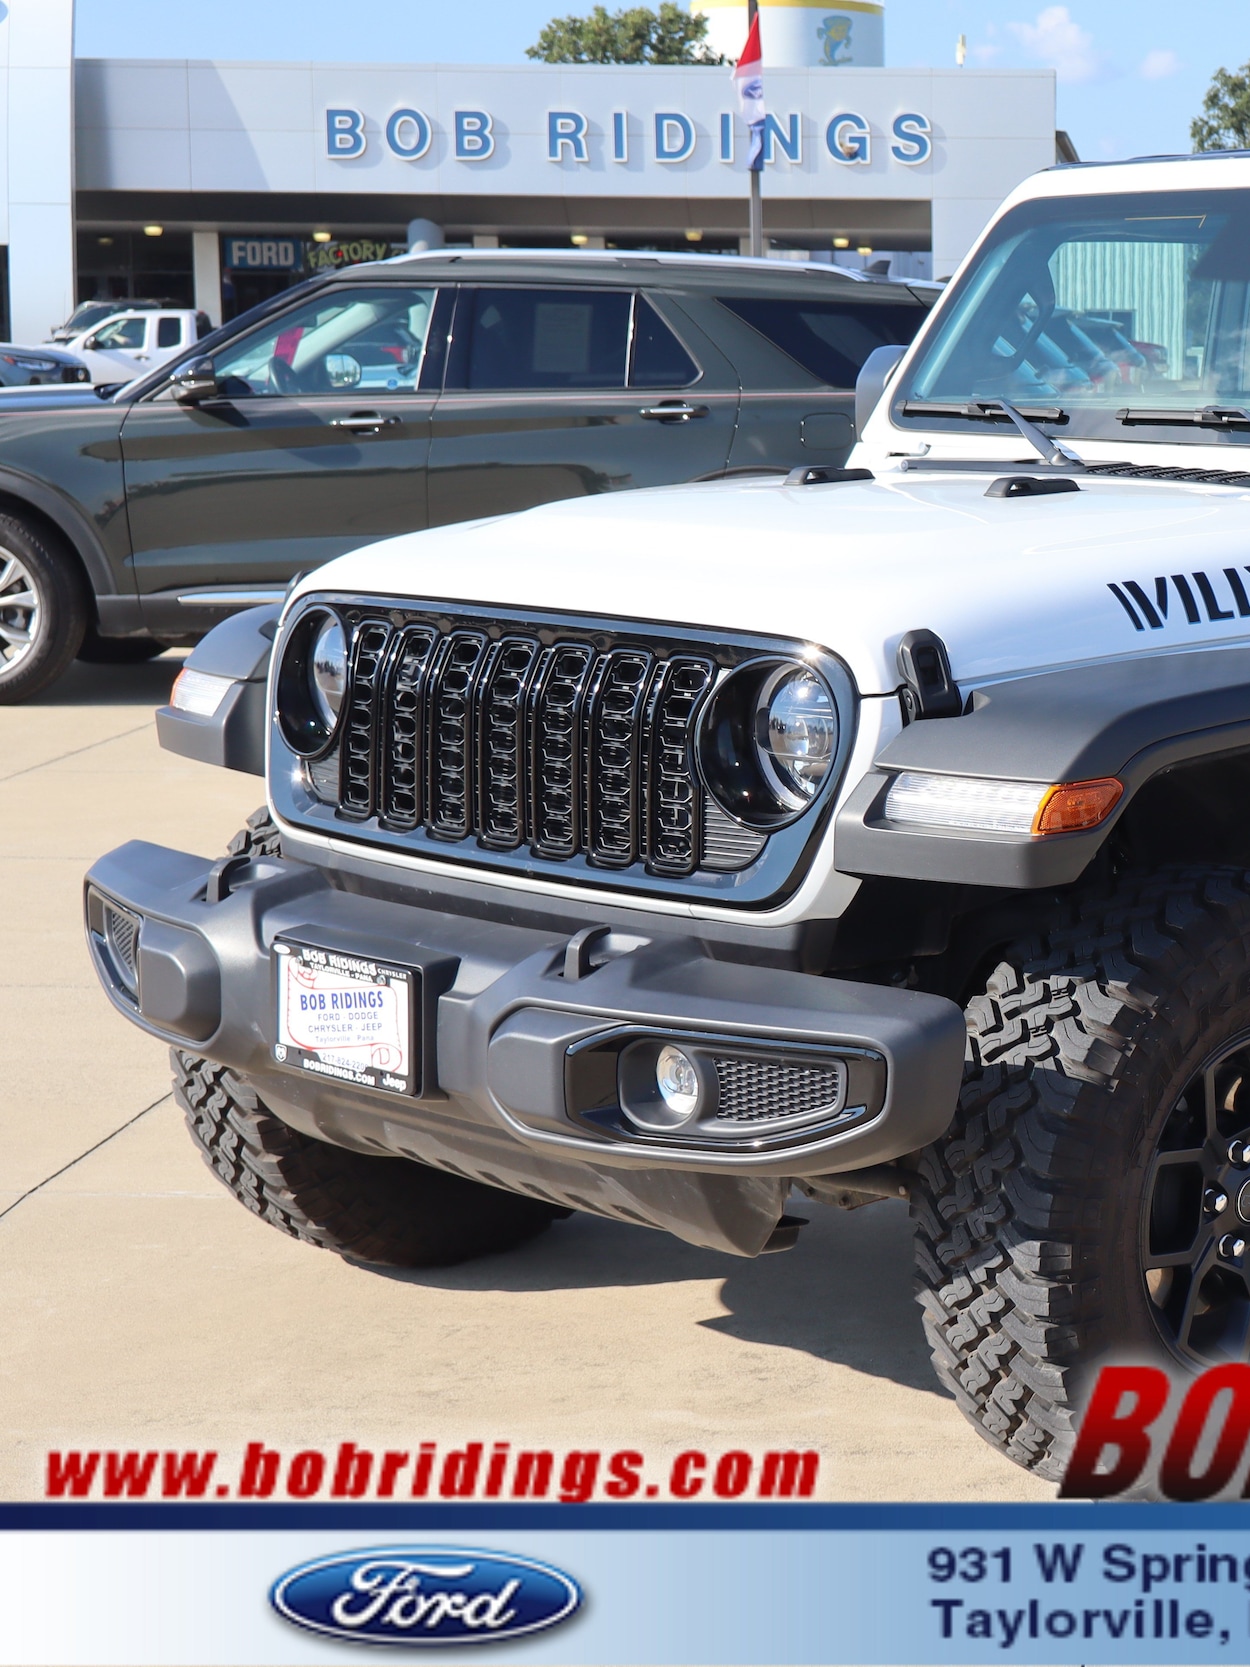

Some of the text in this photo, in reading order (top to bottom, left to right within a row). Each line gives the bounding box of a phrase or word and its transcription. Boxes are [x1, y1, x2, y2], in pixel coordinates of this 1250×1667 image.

[325, 106, 933, 165] BOB RIDINGS
[231, 241, 295, 267] FORD
[307, 239, 388, 269] FACTORY
[302, 949, 378, 976] BOB RIDINGS
[300, 990, 384, 1011] BOB RIDINGS
[308, 1022, 383, 1033] CHRYSLER JEEP
[317, 1011, 379, 1022] FORD DODGE
[303, 1058, 376, 1087] BOBRIDINGS.COM
[382, 1073, 407, 1092] Jeep
